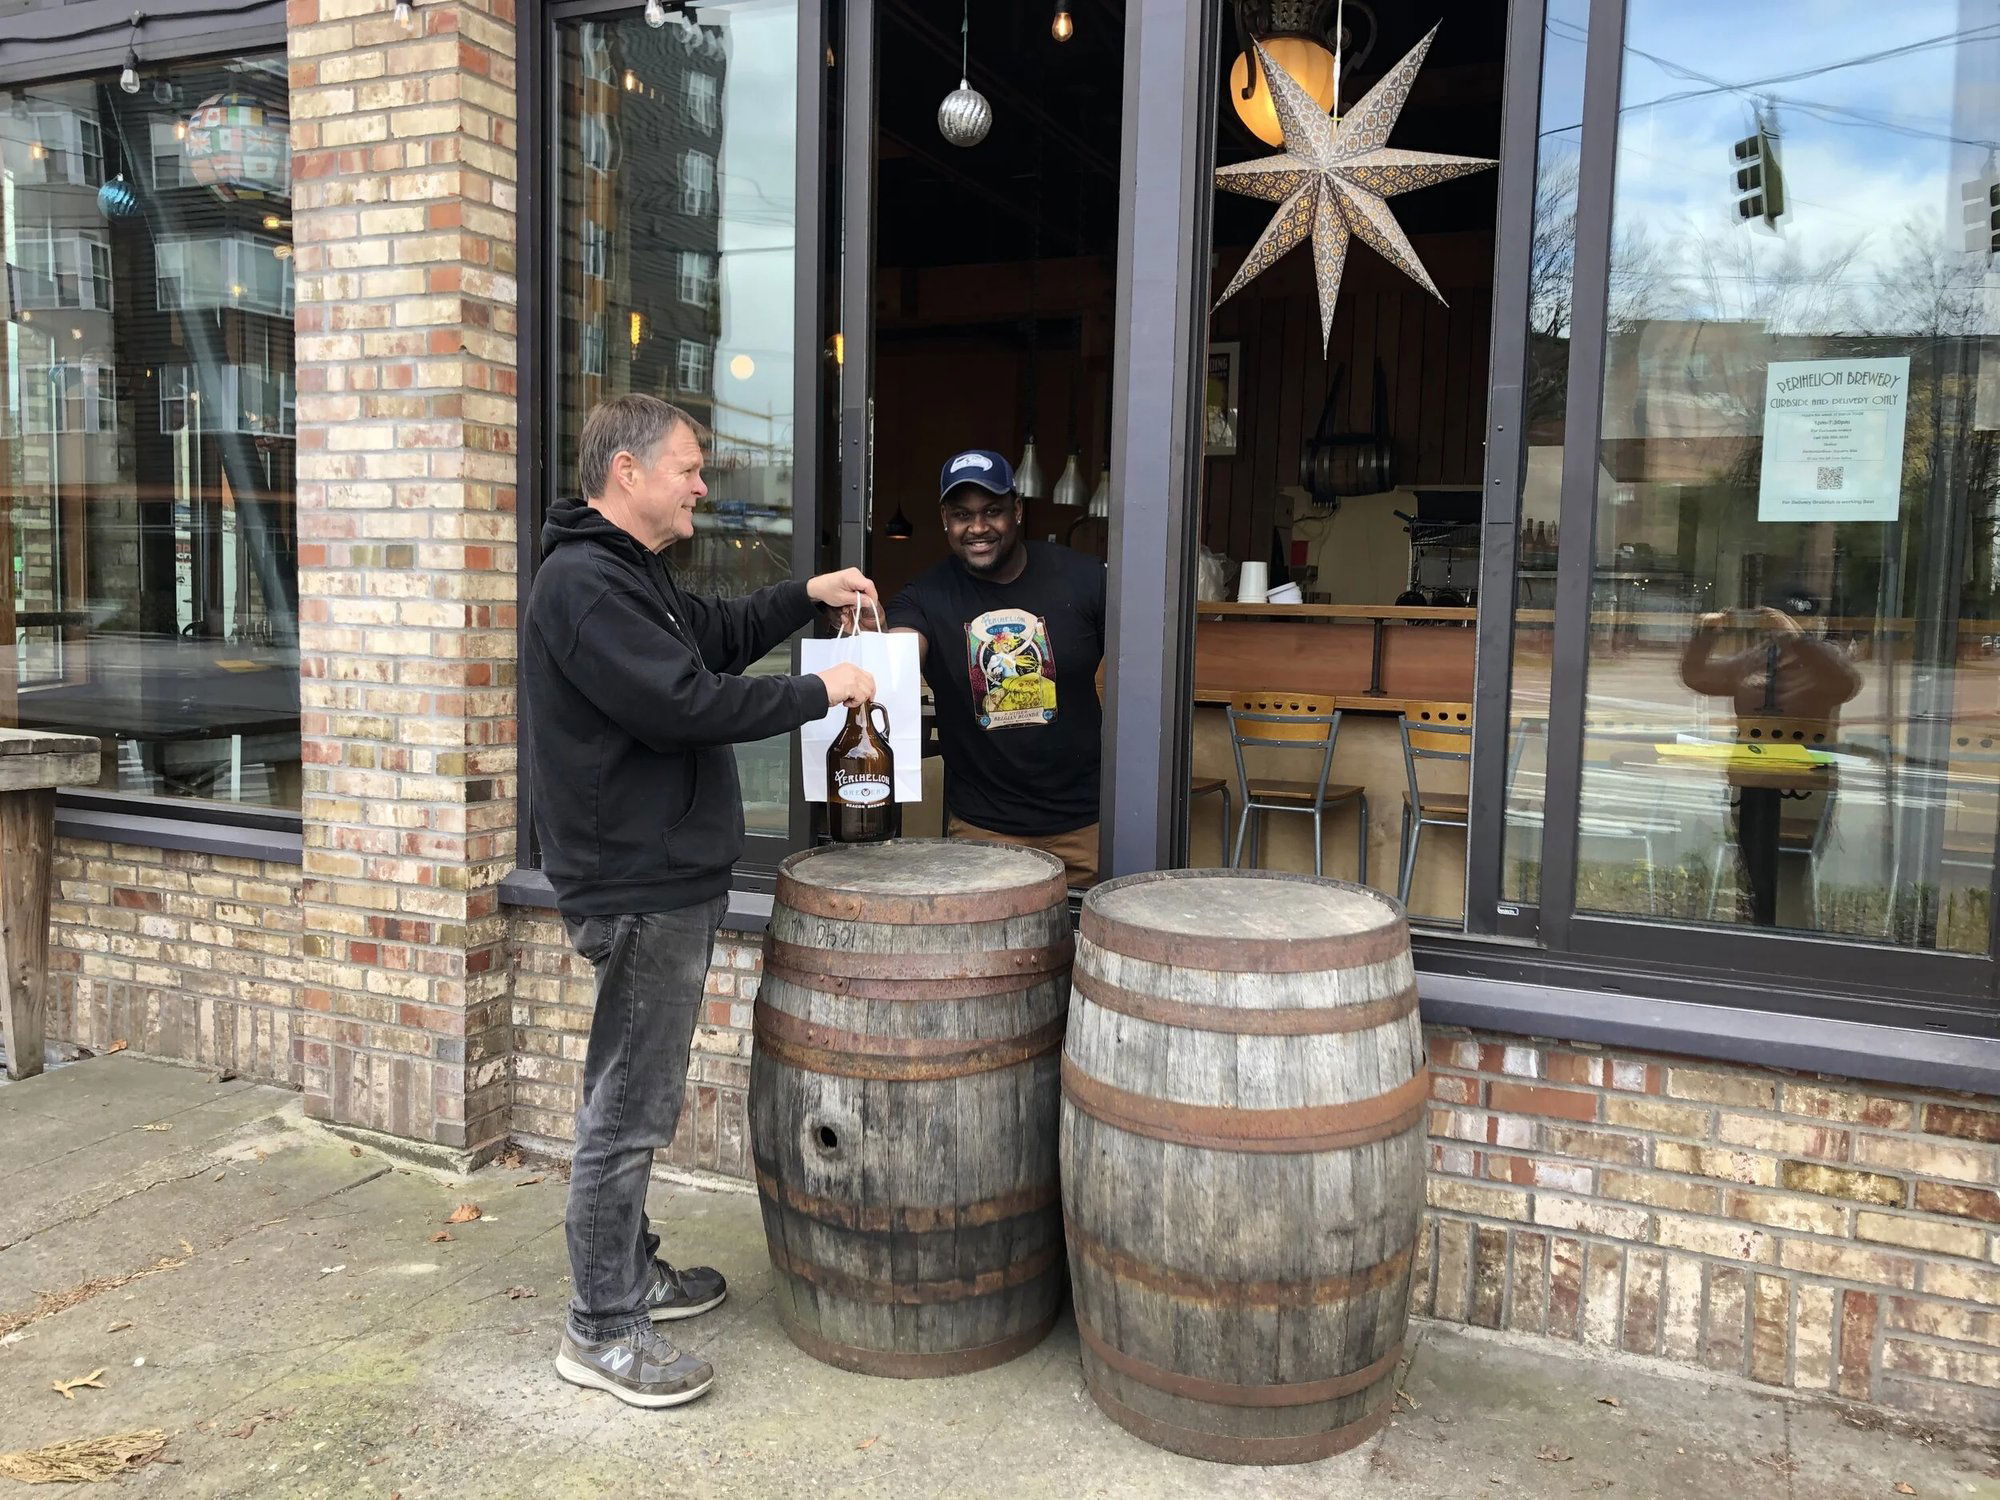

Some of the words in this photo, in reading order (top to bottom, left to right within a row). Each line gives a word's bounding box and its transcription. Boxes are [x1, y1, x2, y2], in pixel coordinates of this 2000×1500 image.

[1776, 371, 1843, 394] PERIHELION
[1846, 371, 1901, 389] BREWERY
[1770, 397, 1809, 409] CURBSIDE
[1811, 398, 1829, 406] AND
[1831, 397, 1869, 405] DELIVERY
[1872, 394, 1898, 405] ONLY
[834, 769, 890, 787] PERIHELION
